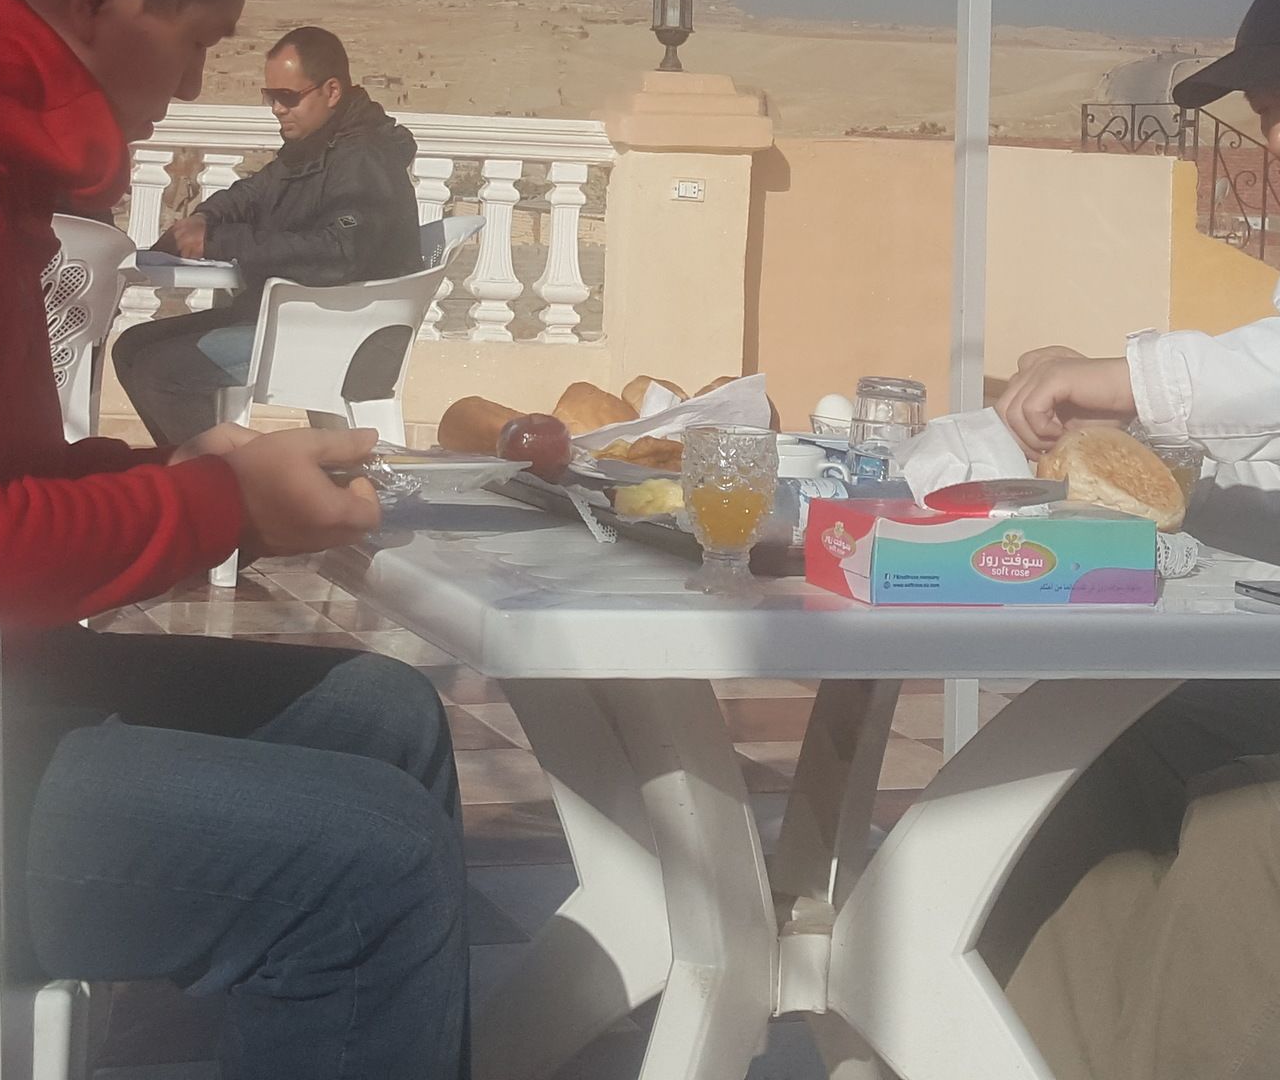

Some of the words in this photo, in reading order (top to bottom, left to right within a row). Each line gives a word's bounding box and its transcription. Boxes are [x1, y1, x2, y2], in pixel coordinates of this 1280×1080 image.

[979, 552, 999, 567] روز
[1001, 553, 1043, 568] سوفت
[991, 566, 1009, 576] soft
[1011, 567, 1030, 577] rose
